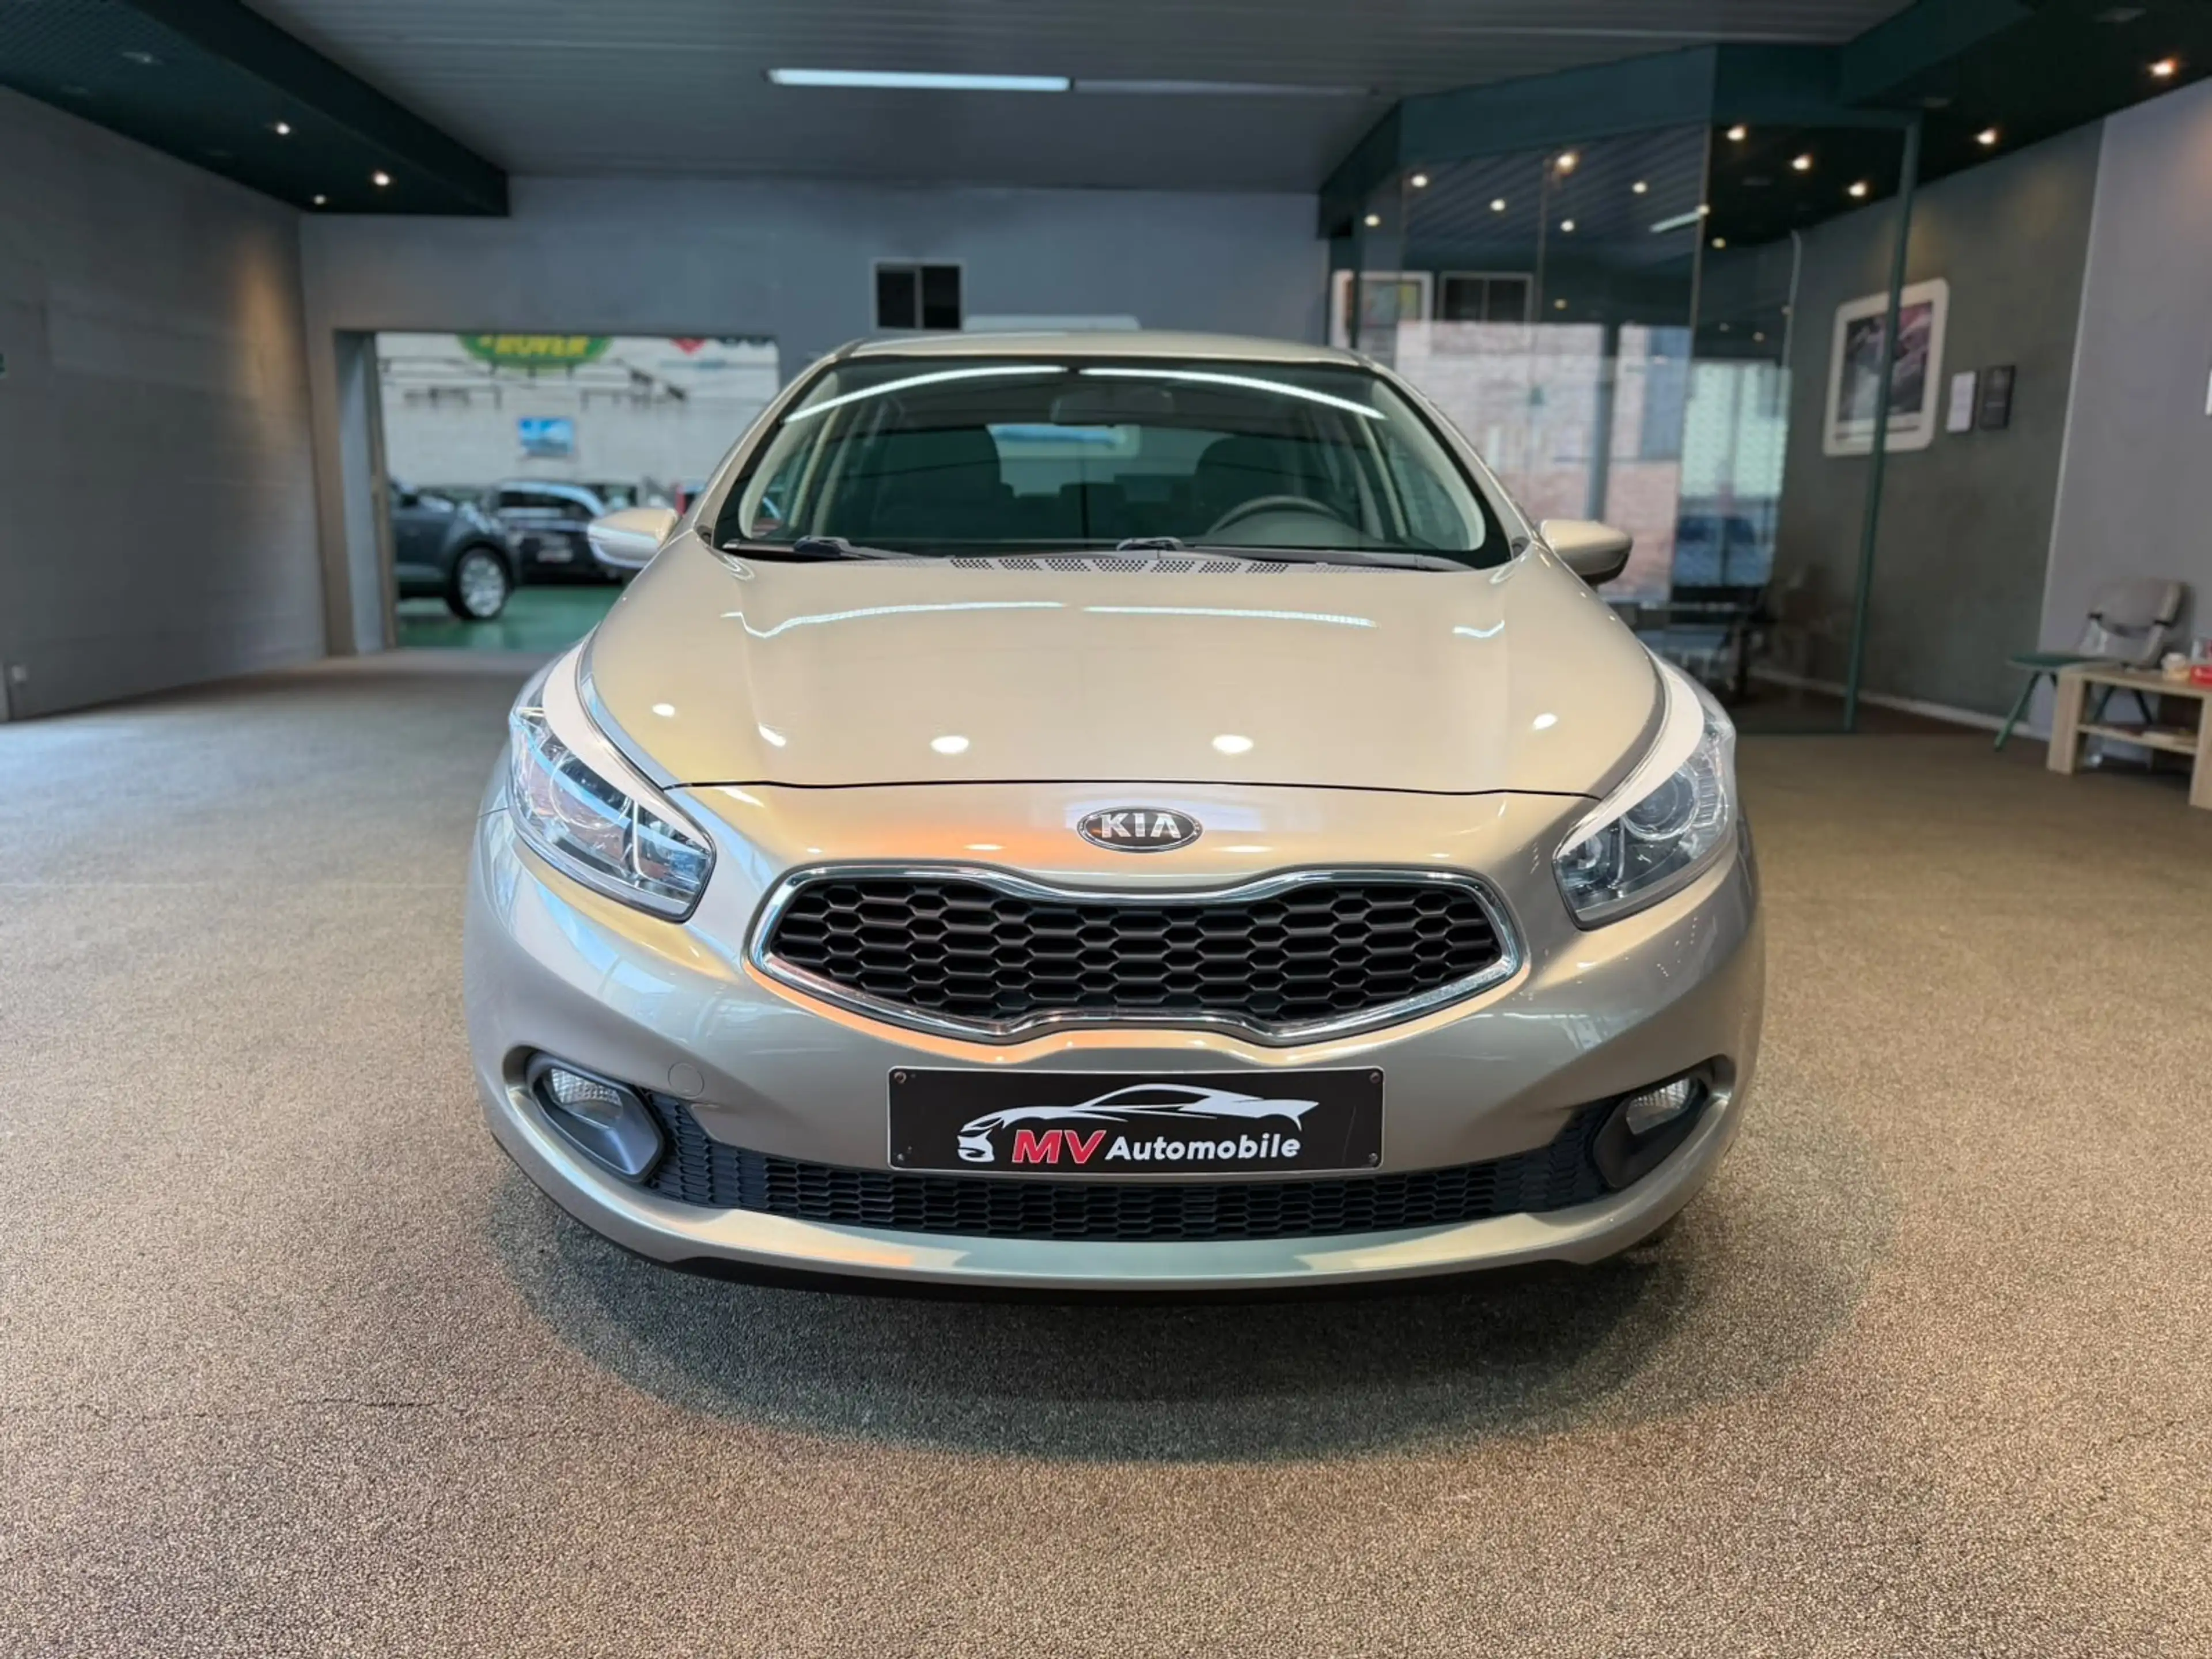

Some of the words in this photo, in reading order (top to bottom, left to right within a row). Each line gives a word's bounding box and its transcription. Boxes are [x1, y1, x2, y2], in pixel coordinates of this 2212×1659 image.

[1101, 813, 1181, 839] KIA
[1012, 1129, 1107, 1164] MV
[1104, 1132, 1301, 1161] Automobile
